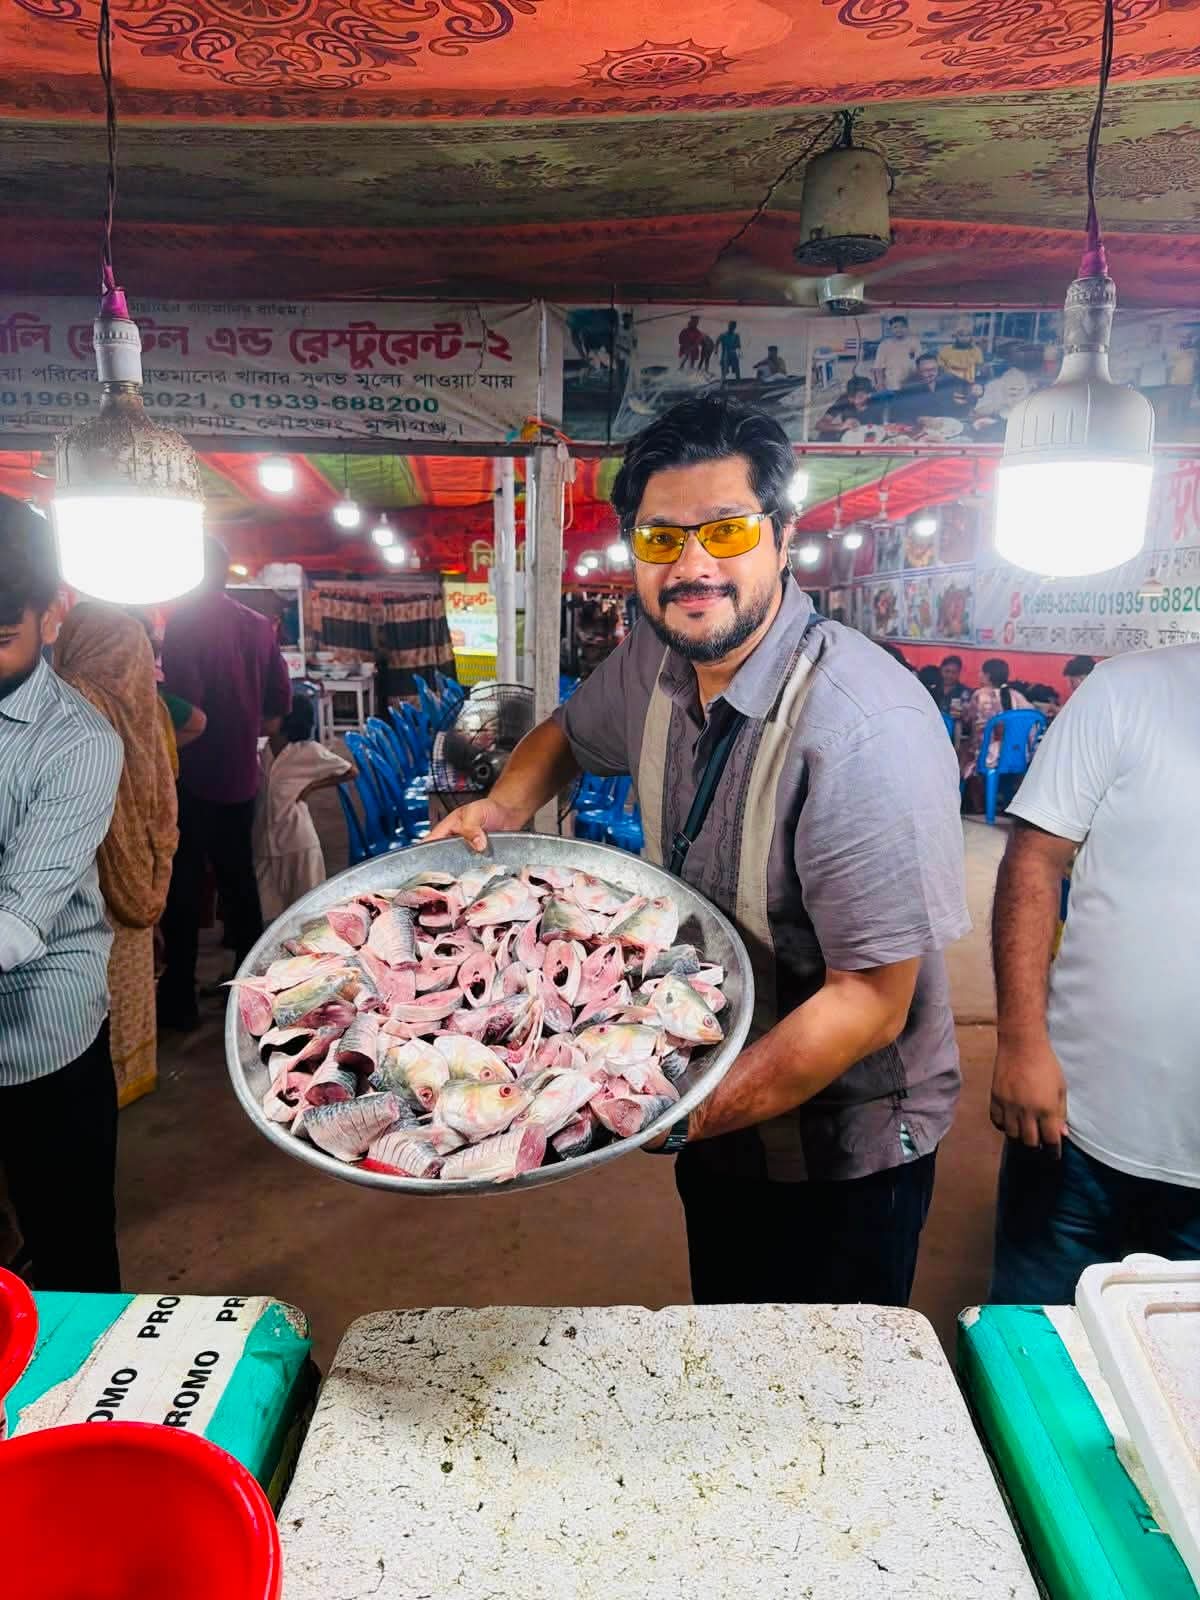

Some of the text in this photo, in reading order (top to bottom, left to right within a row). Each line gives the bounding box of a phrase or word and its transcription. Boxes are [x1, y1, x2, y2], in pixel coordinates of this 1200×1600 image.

[206, 326, 273, 357] এন্ড
[236, 369, 290, 387] খাবার
[230, 393, 440, 414] 01939-688200
